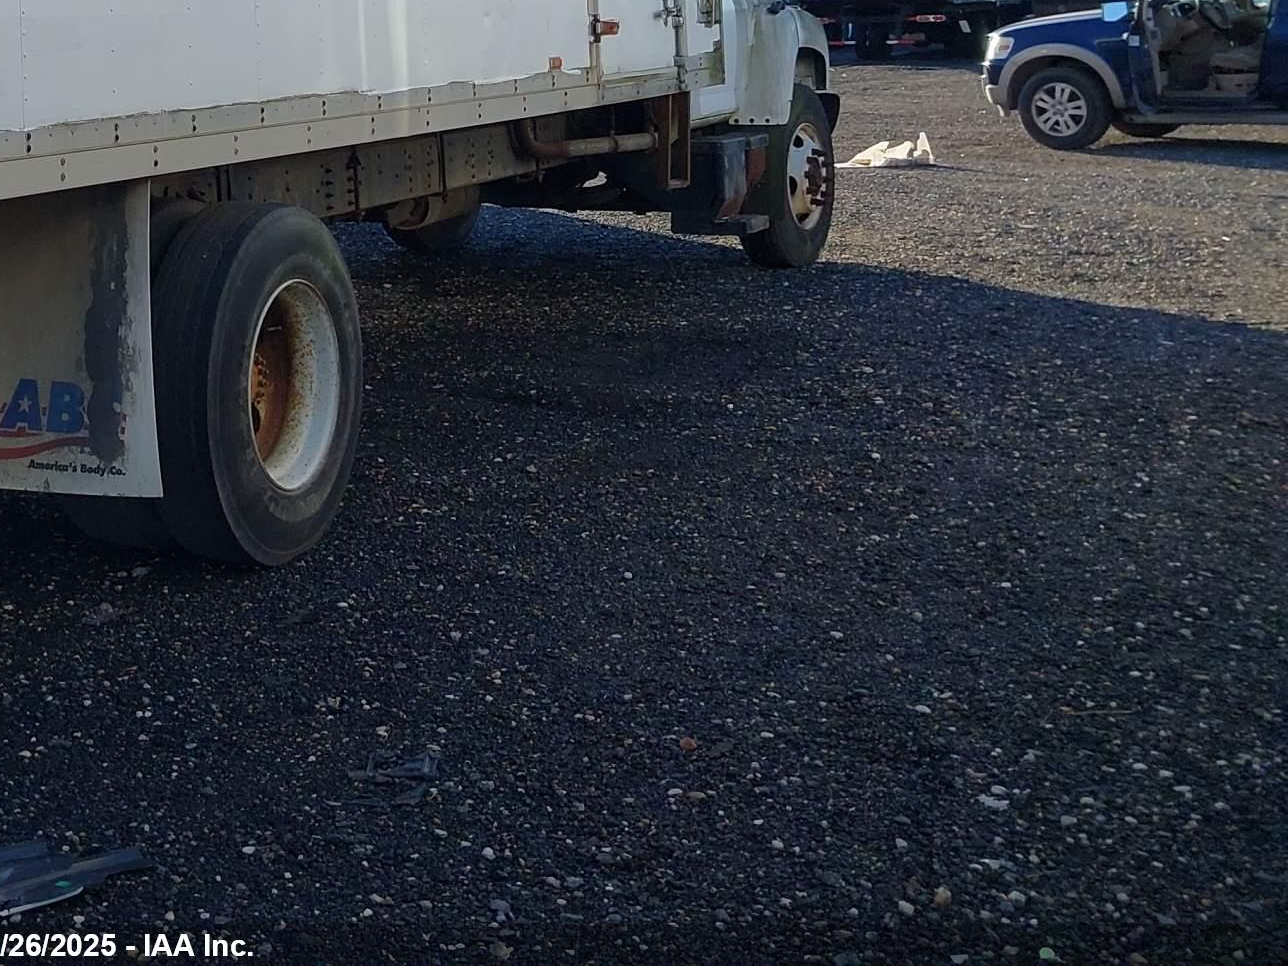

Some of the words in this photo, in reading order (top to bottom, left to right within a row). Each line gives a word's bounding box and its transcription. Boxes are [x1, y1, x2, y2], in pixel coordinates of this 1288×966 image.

[28, 459, 78, 473] America's
[80, 463, 106, 477] Body
[110, 466, 126, 476] Co.
